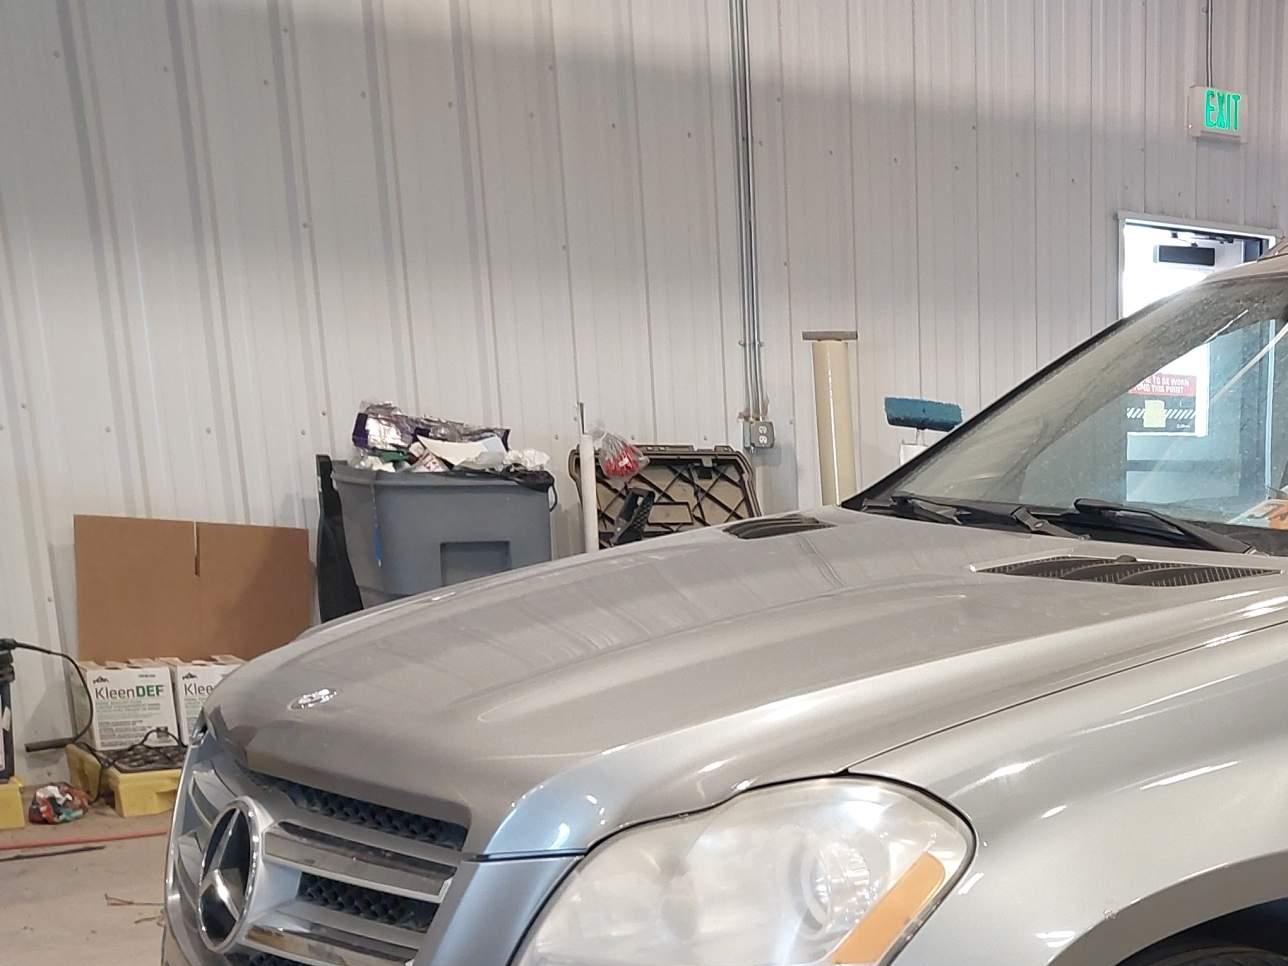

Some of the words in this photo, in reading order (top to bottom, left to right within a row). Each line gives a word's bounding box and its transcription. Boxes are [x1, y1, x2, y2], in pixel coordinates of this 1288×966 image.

[1205, 89, 1241, 130] EXIT
[94, 684, 165, 700] KleenDEF
[183, 682, 215, 697] Klee
